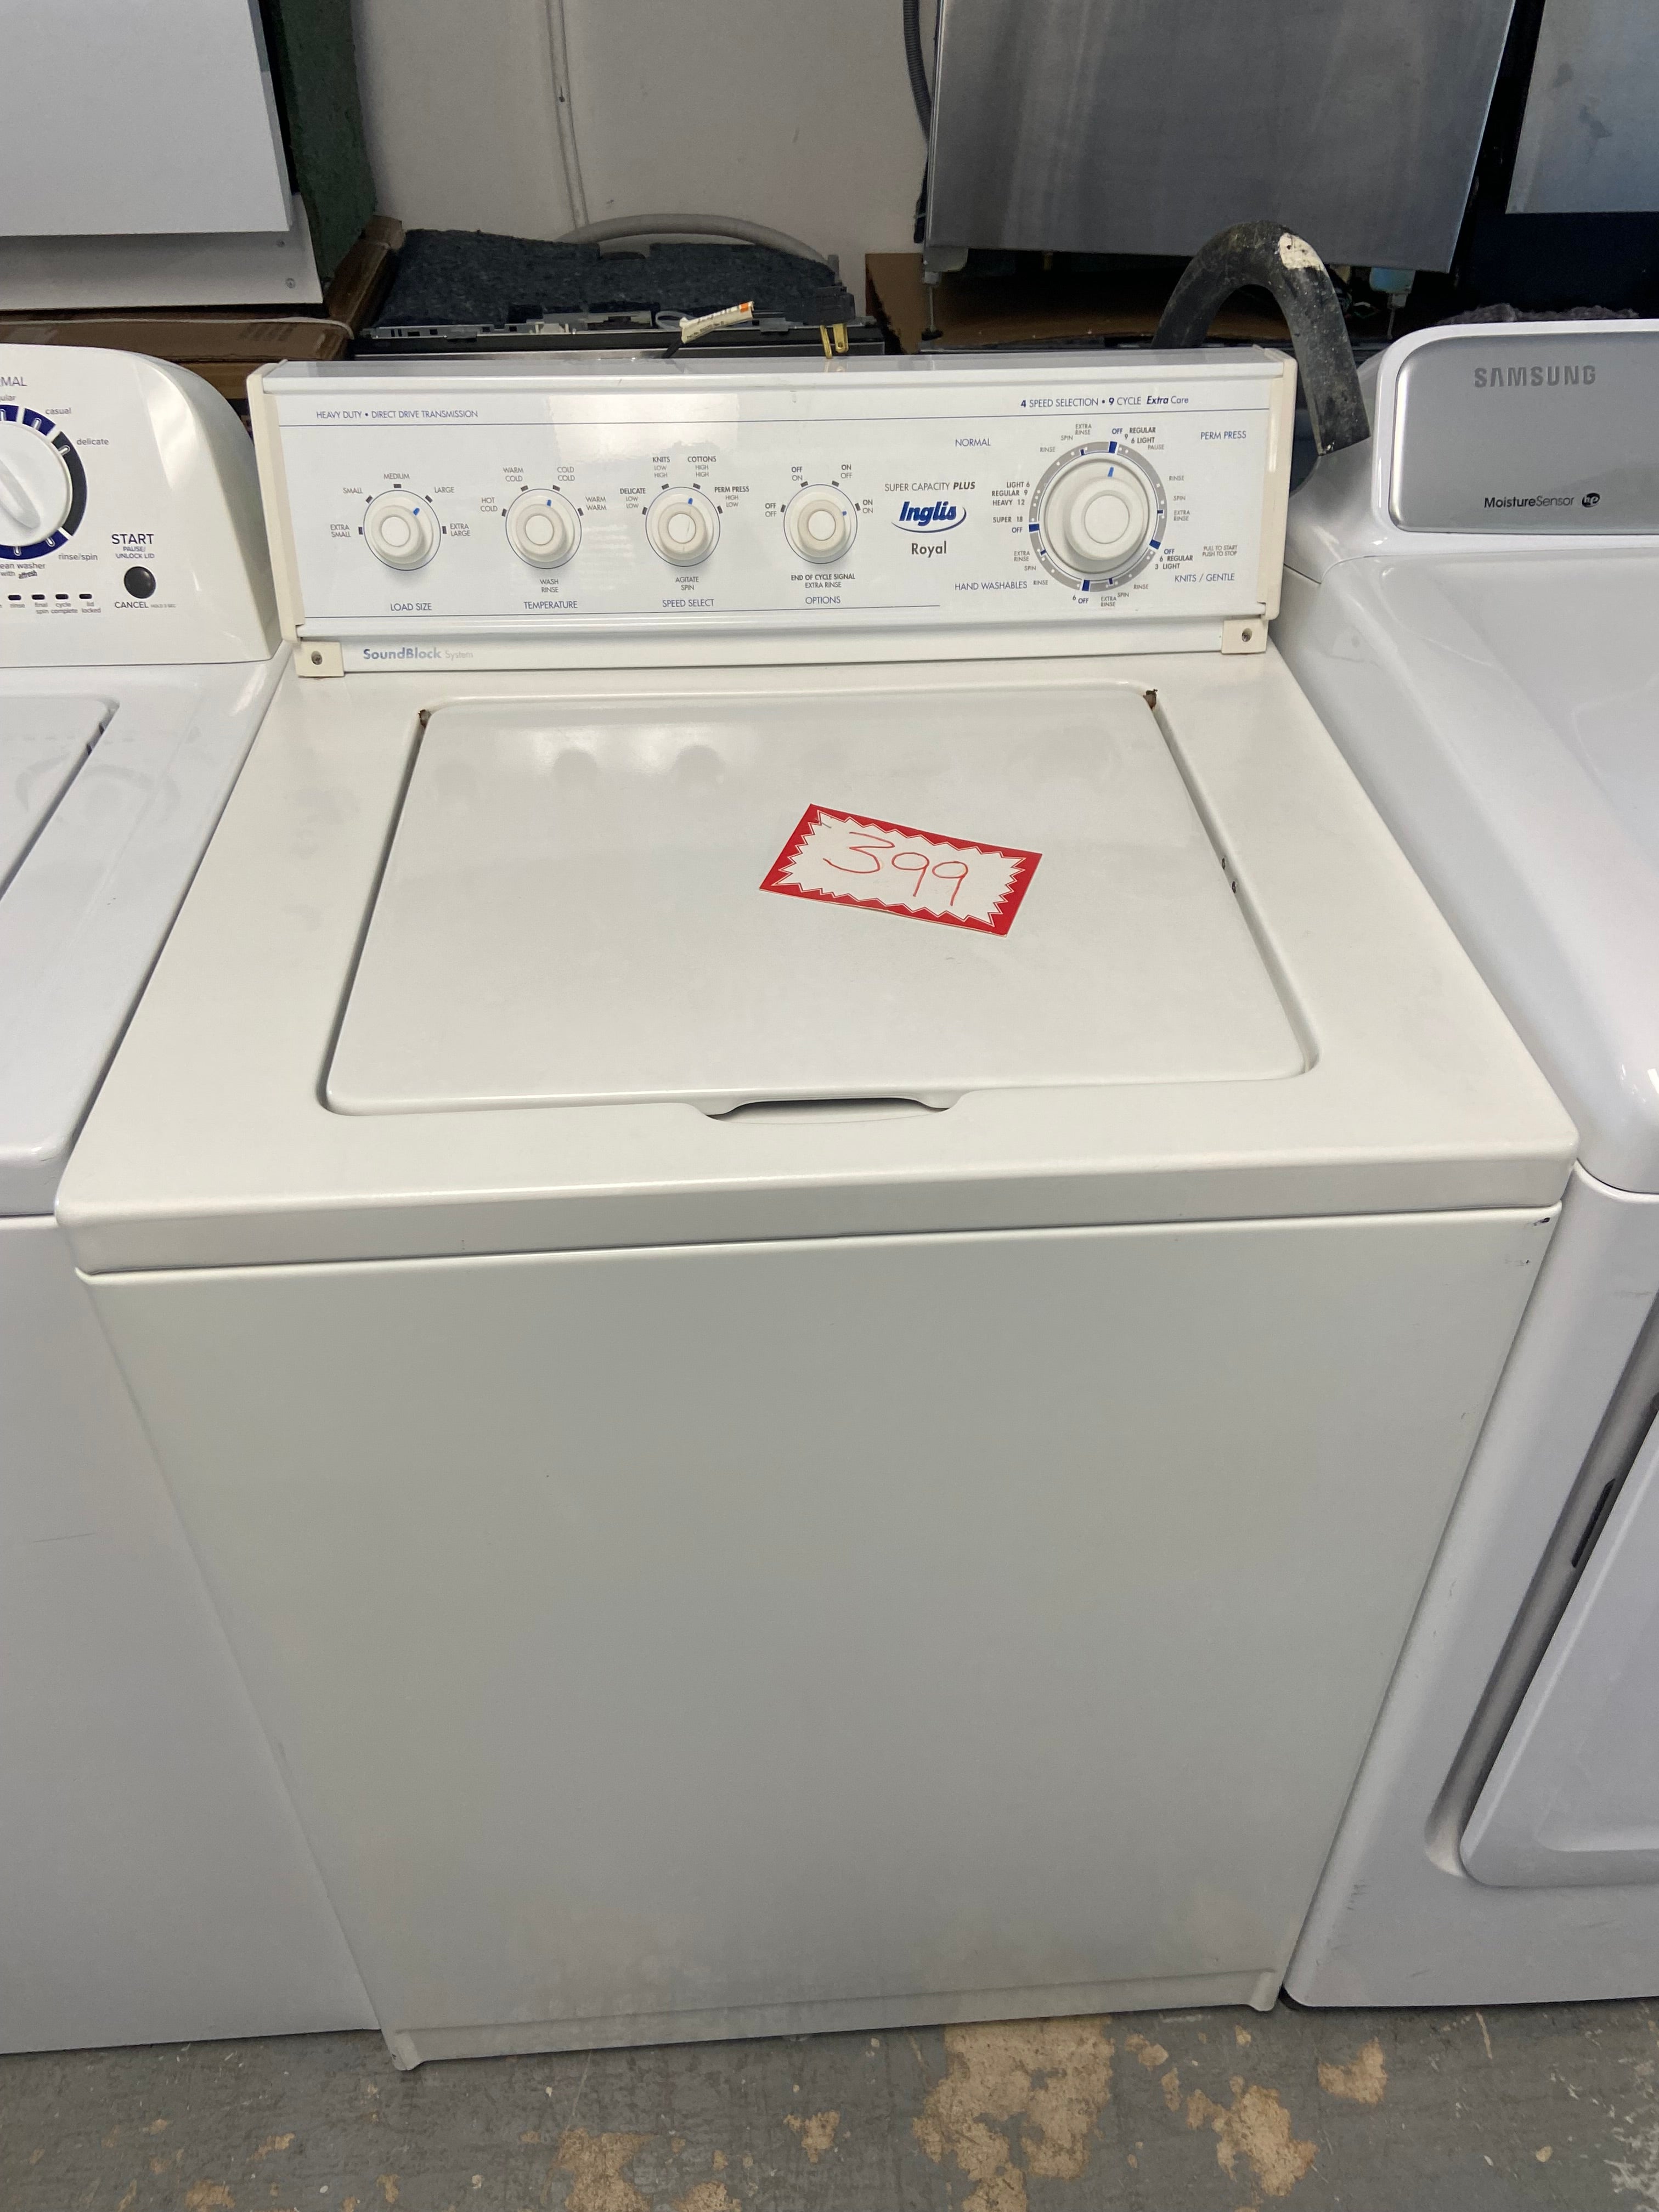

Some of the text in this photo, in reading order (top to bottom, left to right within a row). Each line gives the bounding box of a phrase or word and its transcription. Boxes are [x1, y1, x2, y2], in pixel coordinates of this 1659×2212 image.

[0, 376, 27, 386] MAL
[1474, 365, 1596, 388] SAMSUNG
[1029, 399, 1053, 408] SPEED
[1056, 398, 1098, 407] SELECTION
[1109, 397, 1114, 405] 9
[1117, 397, 1141, 405] CYCLE
[1147, 396, 1169, 404] Extra
[1171, 395, 1189, 404] Care
[1200, 431, 1246, 440] PERM PRESS
[955, 438, 991, 447] NORMAL
[885, 482, 975, 492] SUPER CAPACITY PLUS
[1484, 495, 1575, 508] MoistureSensor
[899, 501, 957, 527] Inglis
[111, 534, 154, 545] START
[911, 540, 947, 558] Royal
[58, 553, 98, 561] rinse/spin
[1175, 574, 1197, 583] KNITS
[1206, 573, 1235, 582] GENTLE
[955, 581, 1028, 590] HAND WASHABLES
[390, 603, 413, 611] LOAD
[523, 601, 578, 609] TEMPERATURE
[688, 599, 714, 607] SELECT
[363, 647, 473, 661] SoundBlock System
[823, 832, 968, 906] 399
